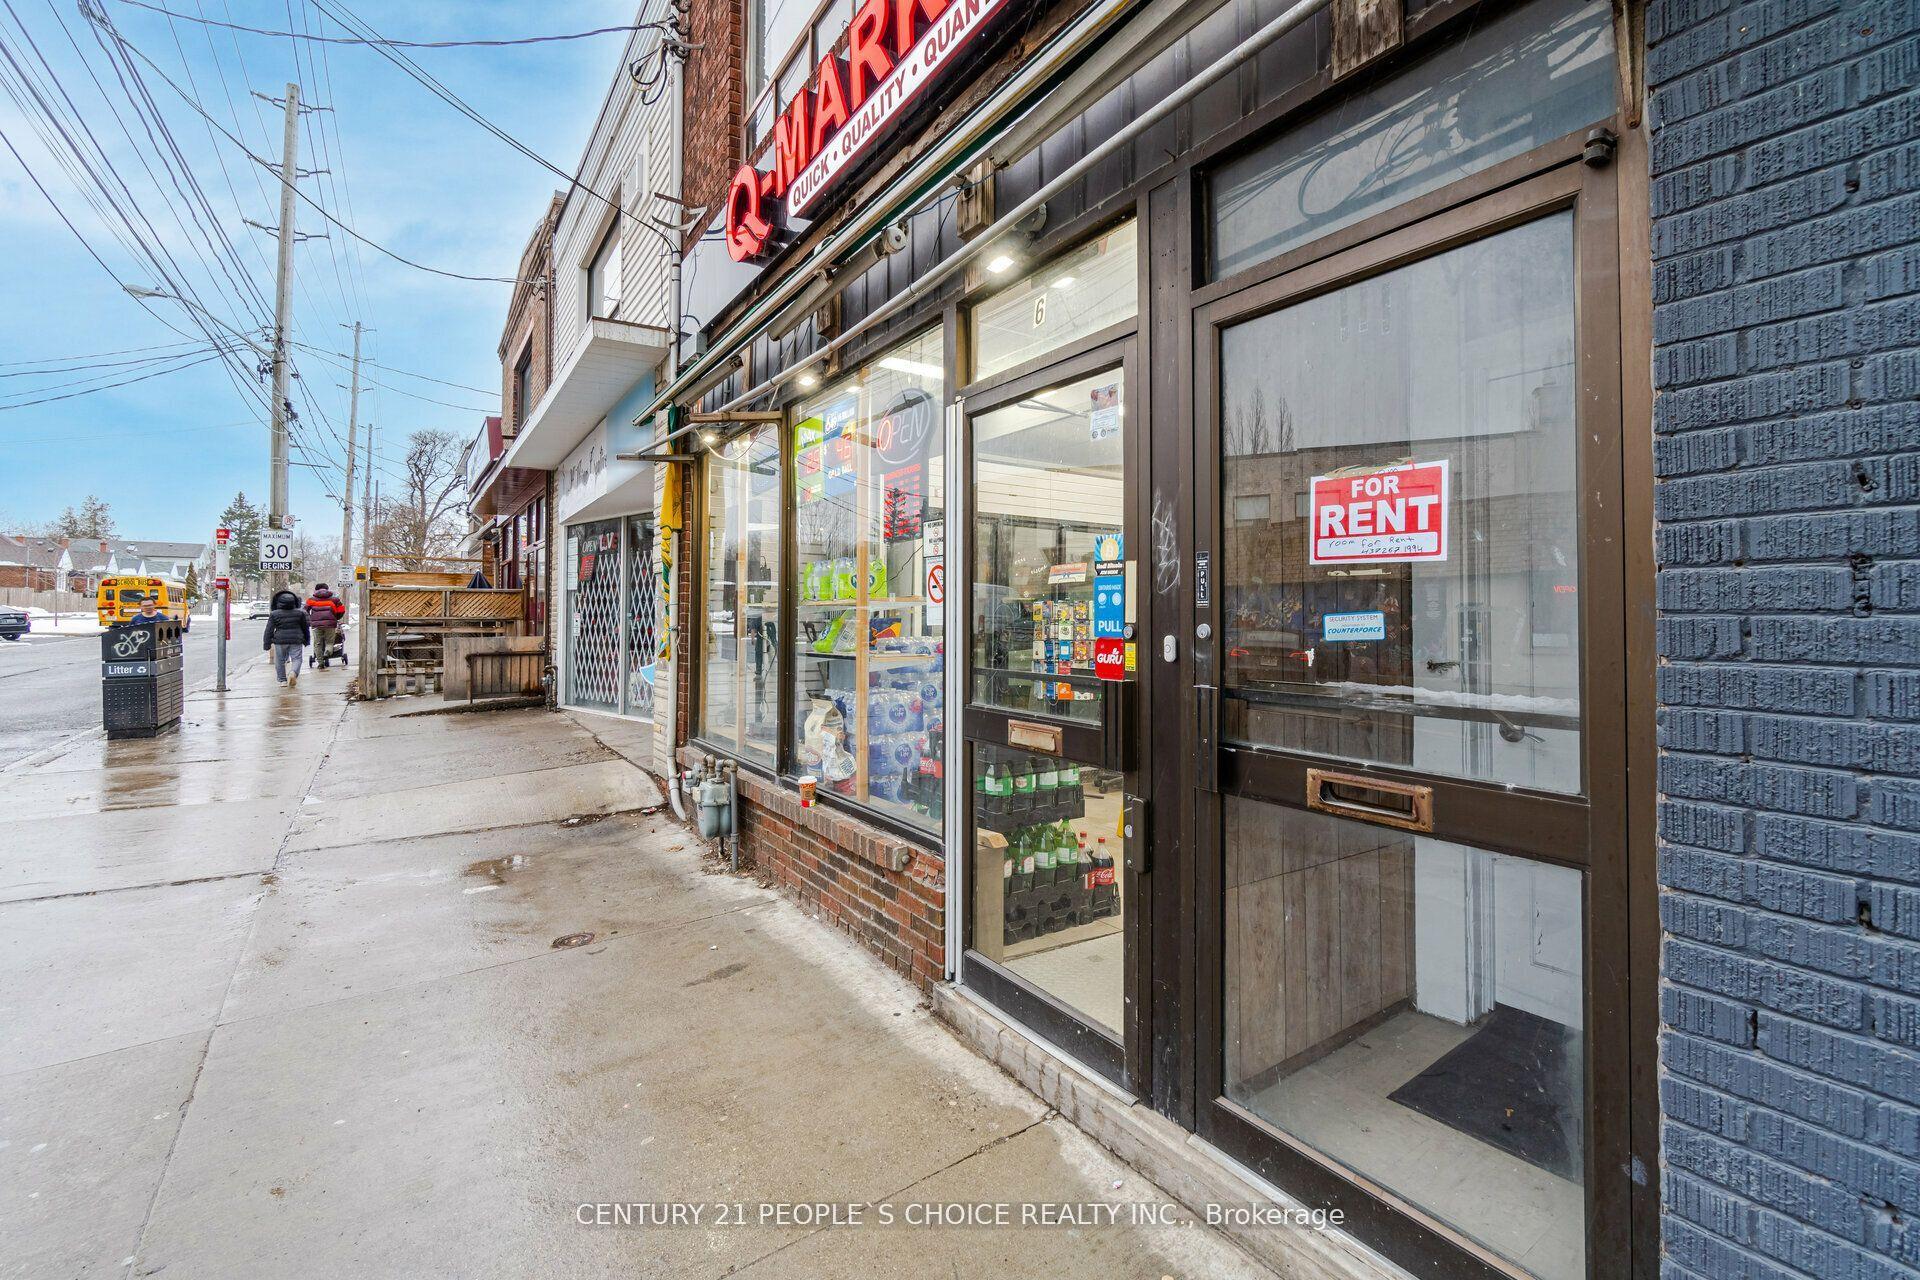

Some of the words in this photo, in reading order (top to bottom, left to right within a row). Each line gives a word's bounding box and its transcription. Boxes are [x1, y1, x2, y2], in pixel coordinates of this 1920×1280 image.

[792, 161, 831, 207] QUICK
[841, 76, 906, 157] QUALITY
[923, 0, 990, 67] QUAN
[1034, 297, 1045, 325] 6
[880, 401, 926, 452] OPEN
[1351, 475, 1400, 499] FOR
[1319, 494, 1439, 537] RENT
[1328, 540, 1356, 548] room
[1361, 538, 1381, 548] for
[1389, 536, 1415, 544] Rent
[264, 544, 289, 559] 30
[262, 562, 290, 570] BEGINS
[1356, 614, 1378, 622] SYSTEM
[1098, 620, 1123, 632] PULL
[1327, 626, 1382, 634] COUNTERFORCE
[1097, 653, 1123, 665] GURU
[108, 665, 134, 675] Litter
